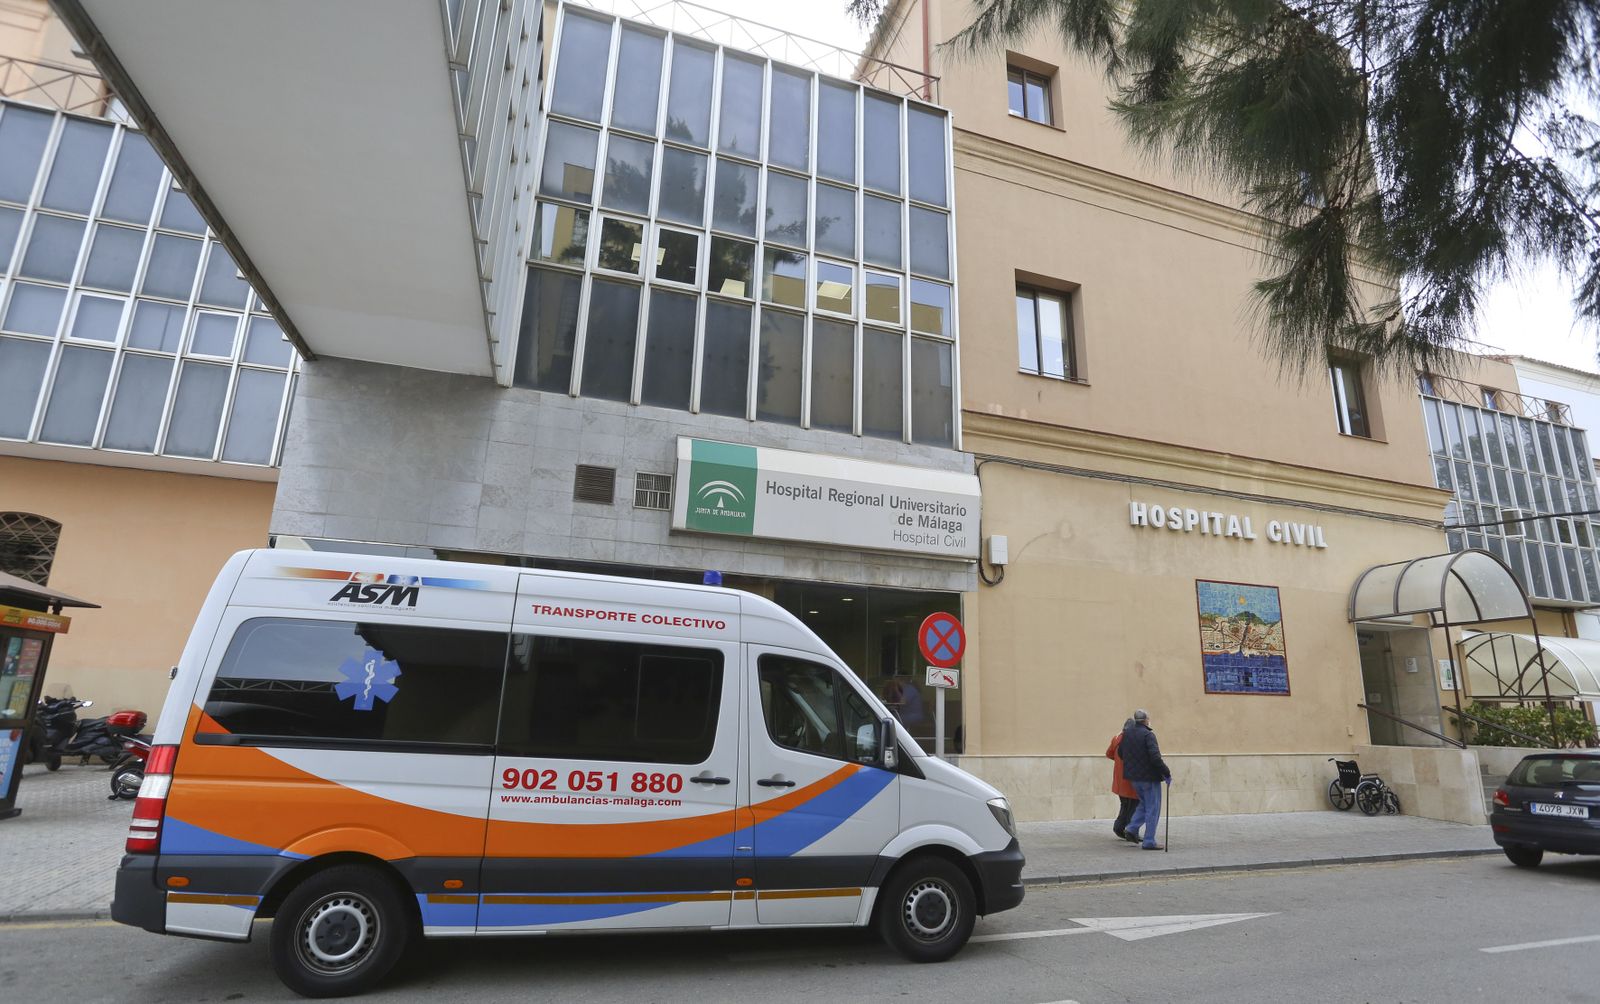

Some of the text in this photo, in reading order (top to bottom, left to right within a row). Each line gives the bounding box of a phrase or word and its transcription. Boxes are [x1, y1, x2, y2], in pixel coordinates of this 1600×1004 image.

[765, 480, 967, 517] Hospital Regional Universitario
[897, 512, 963, 533] de Málaga
[1129, 501, 1328, 549] HOSPITAL CIVIL
[893, 531, 967, 549] Hospital Civil
[329, 582, 420, 607] ASM
[532, 604, 726, 630] TRANSPORTE COLECTIVO
[502, 768, 684, 794] 902 051 880
[500, 794, 682, 808] www.ambulancias-malaga.com
[1539, 804, 1584, 816] 4078 JXW
